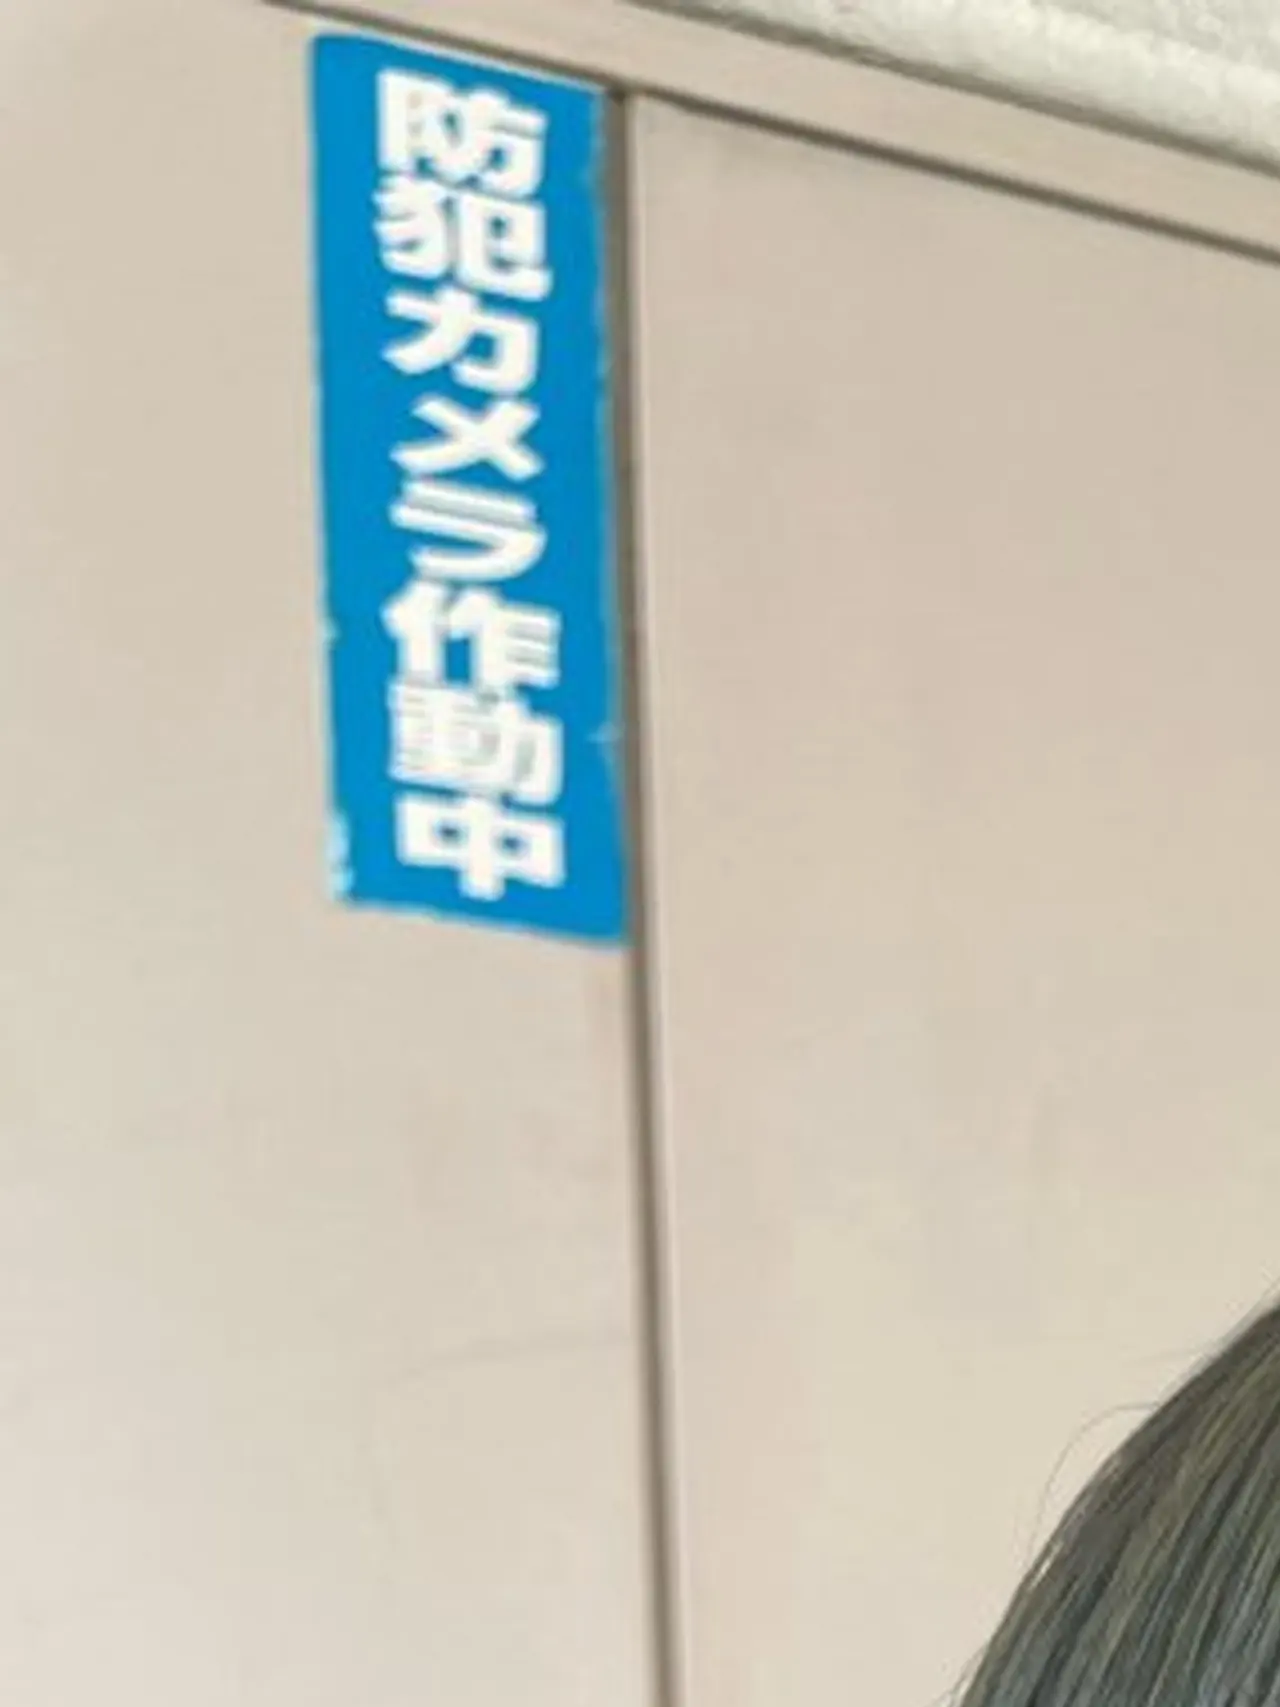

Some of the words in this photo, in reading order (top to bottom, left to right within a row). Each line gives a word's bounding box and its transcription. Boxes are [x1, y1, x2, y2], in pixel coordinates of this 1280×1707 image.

[374, 68, 566, 900] 防犯カメラ作動中
